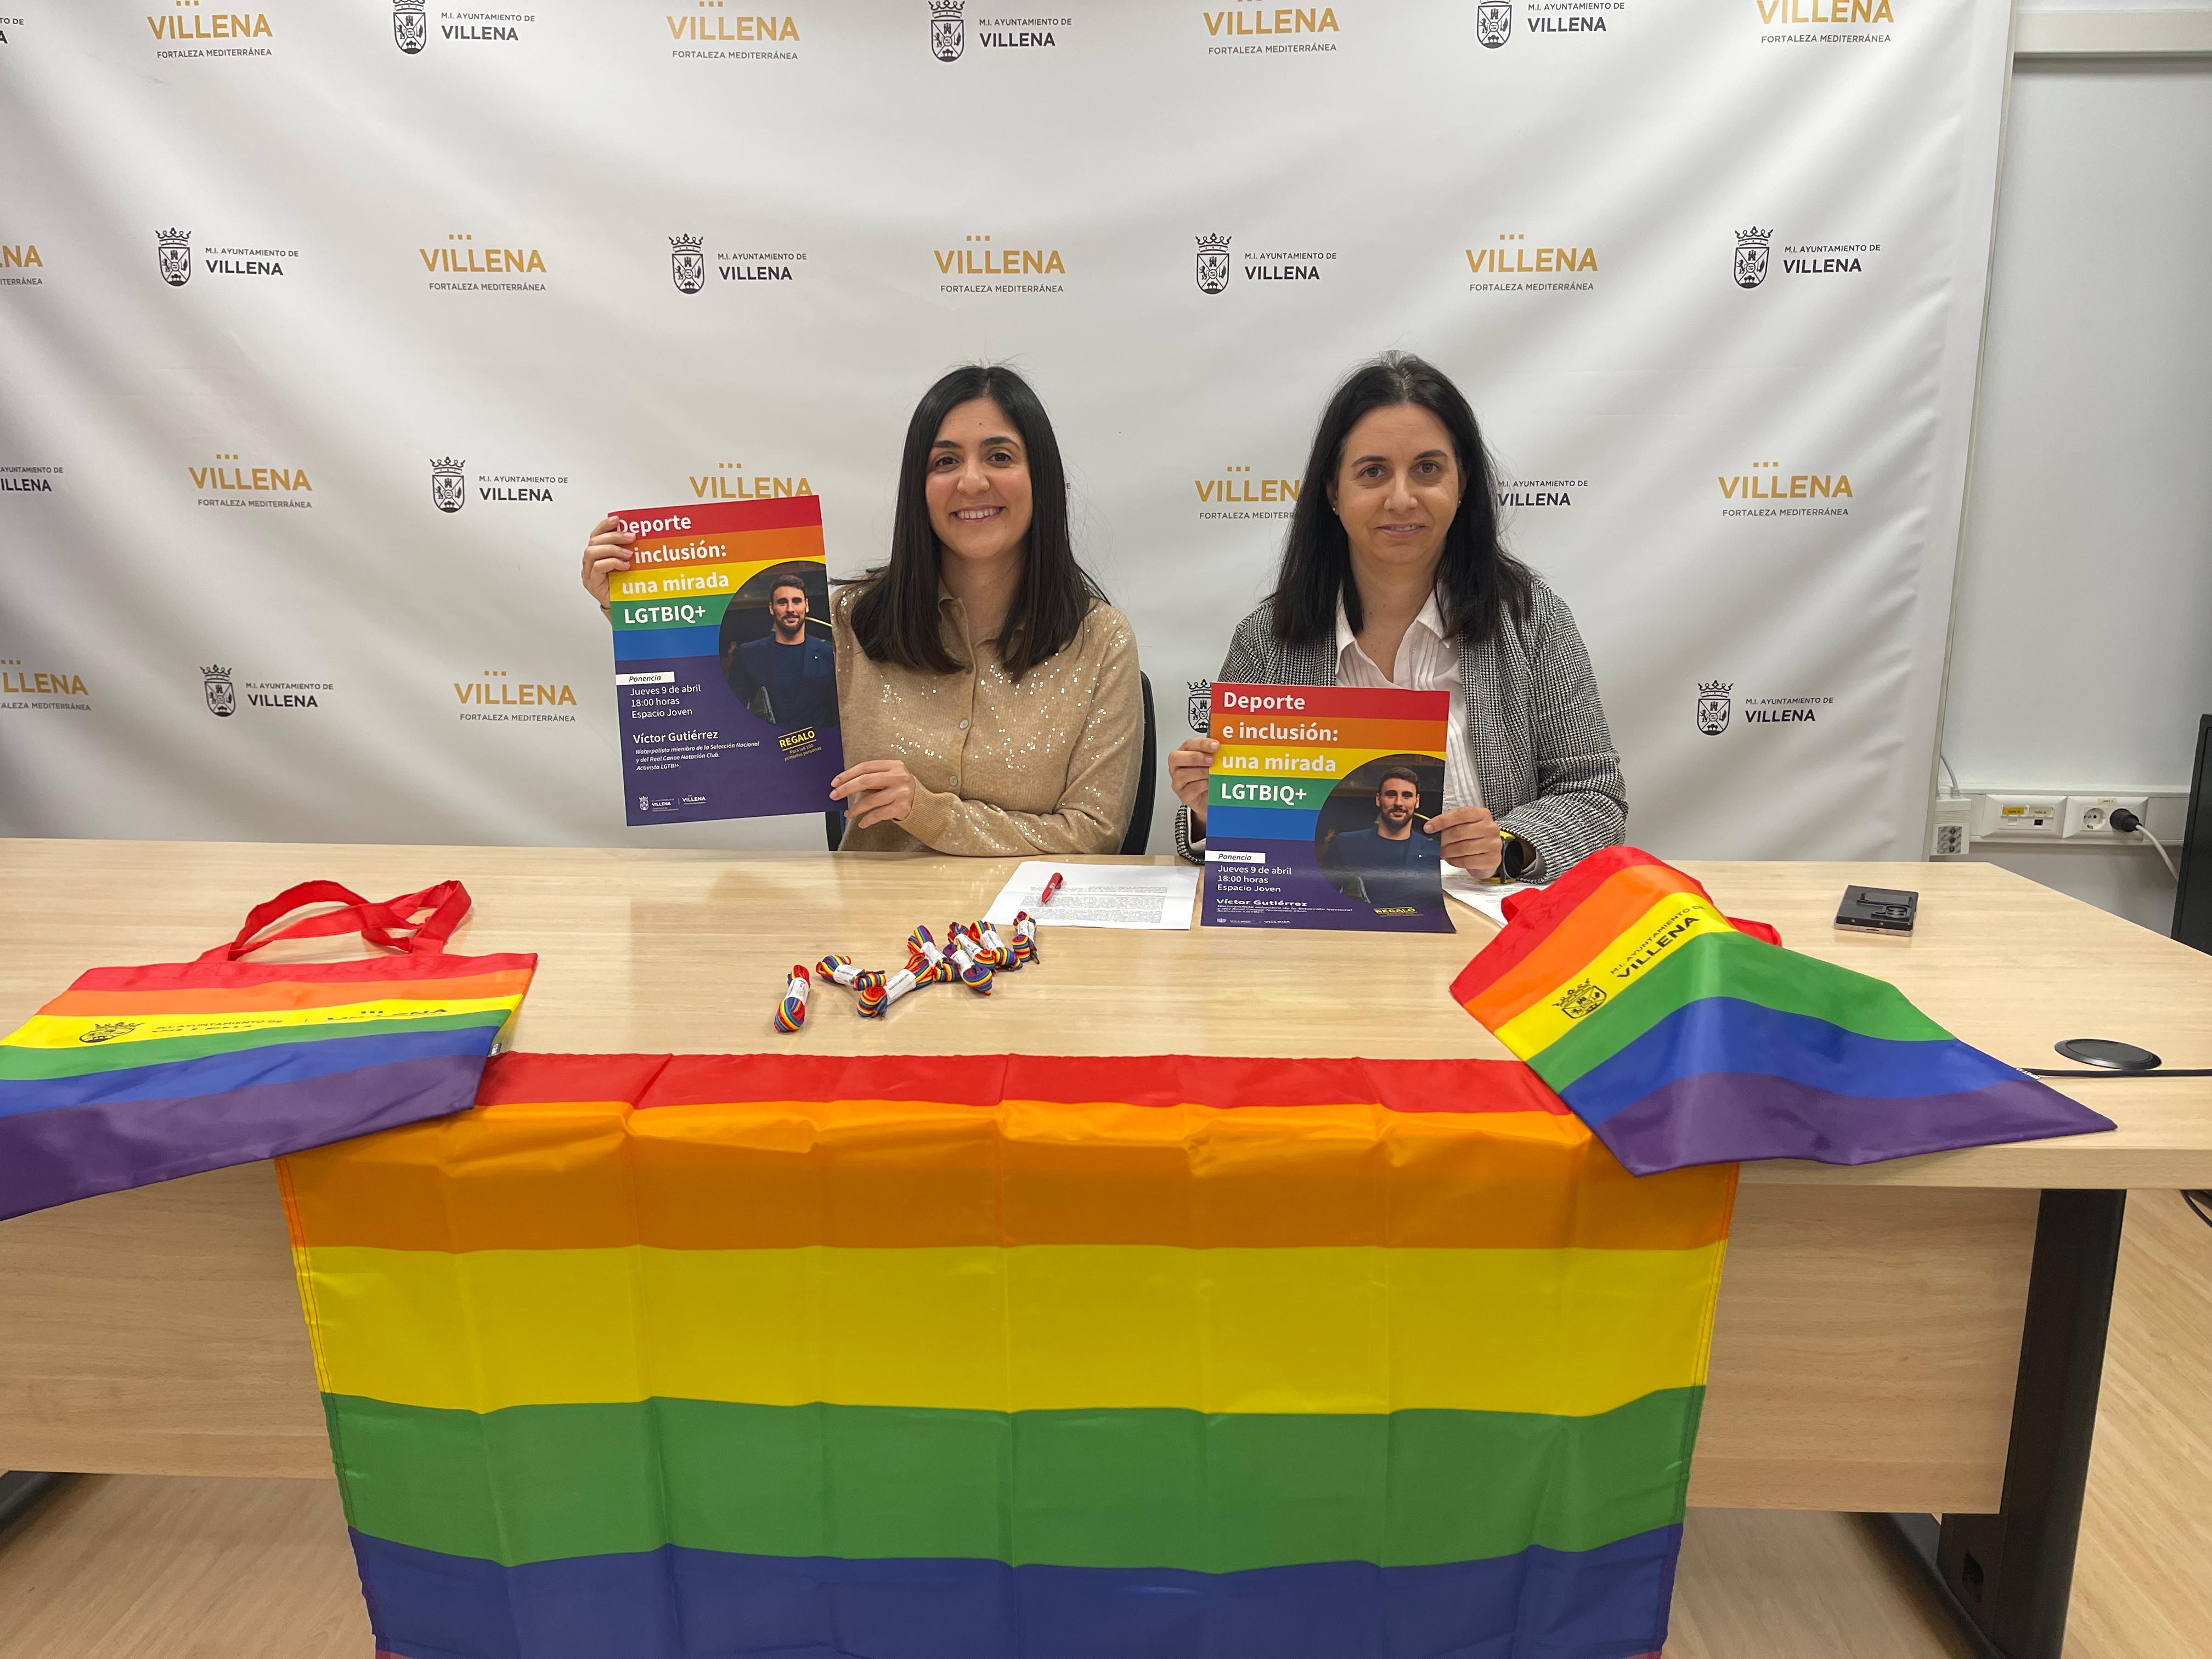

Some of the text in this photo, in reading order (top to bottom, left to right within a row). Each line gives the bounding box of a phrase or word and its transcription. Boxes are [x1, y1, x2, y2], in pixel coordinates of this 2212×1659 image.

[1757, 0, 1893, 23] VILLENA
[147, 14, 272, 40] VILLENA
[667, 16, 800, 41] VILLENA
[1203, 8, 1339, 35] VILLENA
[1527, 17, 1606, 32] VILLENA
[441, 26, 518, 41] VILLENA
[980, 33, 1055, 47] VILLENA
[1820, 34, 1891, 42] MEDITERRÁNEA
[157, 47, 272, 58] FORTALEZA MEDITERRÁNEA
[729, 51, 798, 59] MEDITERRÁNEA
[1209, 43, 1336, 54] FORTALEZA MEDITERRÁNEA
[206, 260, 283, 275] VILLENA
[420, 249, 546, 272] VILLENA
[934, 250, 1065, 274] VILLENA
[1466, 248, 1598, 272] VILLENA
[1784, 258, 1861, 273] VILLENA
[719, 267, 792, 280] VILLENA
[1245, 266, 1319, 279] VILLENA
[481, 283, 546, 291] MEDITERRÁNEA
[996, 284, 1063, 292] MEDITERRÁNEA
[1526, 281, 1593, 290] MEDITERRÁNEA
[1, 478, 52, 491] ILLENA
[189, 467, 312, 490] VILLENA
[689, 477, 812, 498] VILLENA
[1194, 480, 1300, 501] VILLEN
[1718, 475, 1853, 498] VILLENA
[479, 488, 553, 501] VILLENA
[1498, 493, 1571, 506] VILLENA
[249, 500, 312, 508] MEDITERRÁNEA
[1780, 507, 1848, 516] MEDITERRÁNEA
[617, 515, 691, 537] Deporte
[635, 540, 726, 563] inclusión:
[623, 572, 729, 594] una mirada
[625, 605, 706, 623] LGTBIQ+
[3, 672, 88, 695] LLENA
[682, 684, 701, 692] abril
[247, 694, 318, 707] VILLENA
[454, 684, 577, 706] VILLENA
[1224, 692, 1305, 712] Deporte
[632, 711, 664, 719] Espacio
[1745, 709, 1815, 723] VILLENA
[633, 730, 718, 743] Víctor Gutiérrez
[1223, 722, 1338, 741] e inclusión:
[779, 731, 815, 748] REGALO
[1223, 754, 1335, 771] una mirada
[1222, 783, 1306, 805] LGTBIQ+
[1218, 853, 1252, 861] Ponencia
[1627, 908, 1691, 961] AYUNTAMIENTO
[1617, 917, 1700, 977] VILLENA
